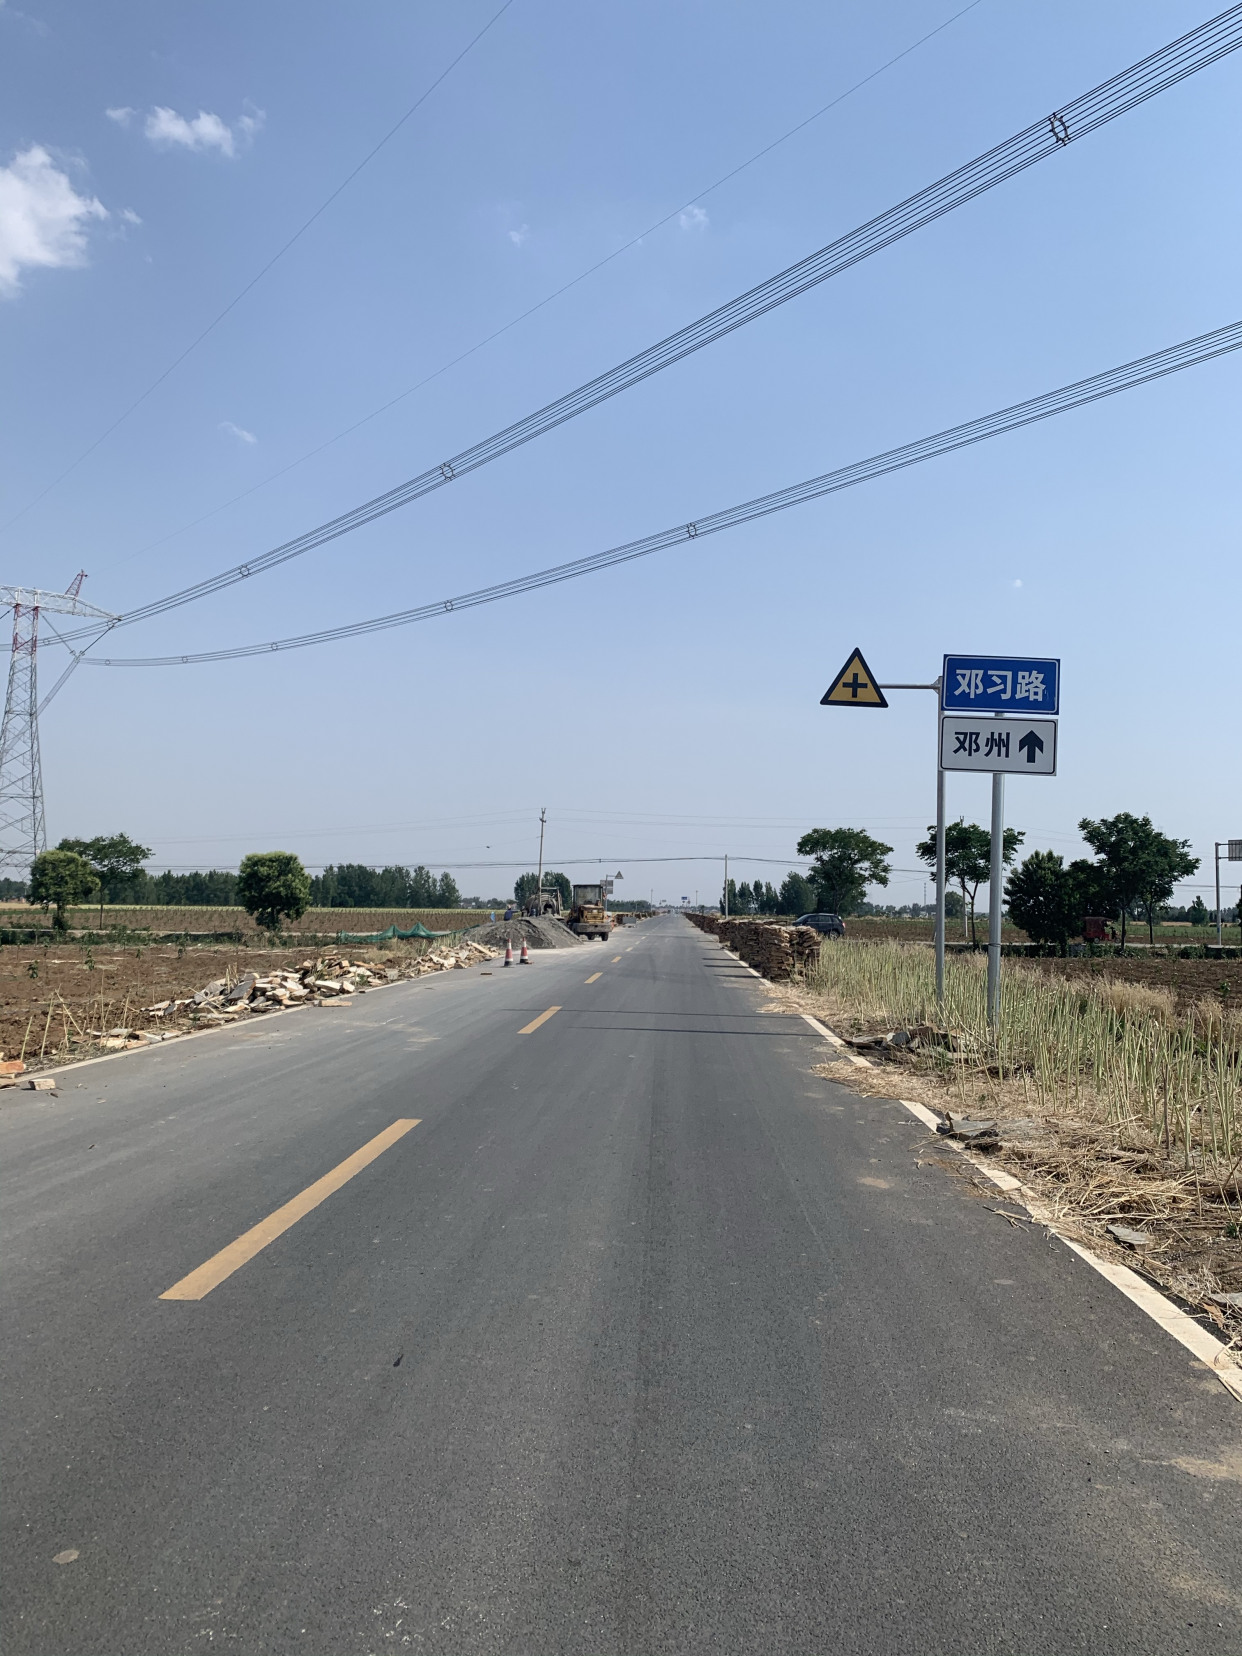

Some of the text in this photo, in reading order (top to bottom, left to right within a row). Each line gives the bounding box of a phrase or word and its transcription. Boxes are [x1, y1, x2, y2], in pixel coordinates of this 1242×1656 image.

[954, 669, 1046, 702] 邓习路
[953, 731, 1010, 758] 邓州
